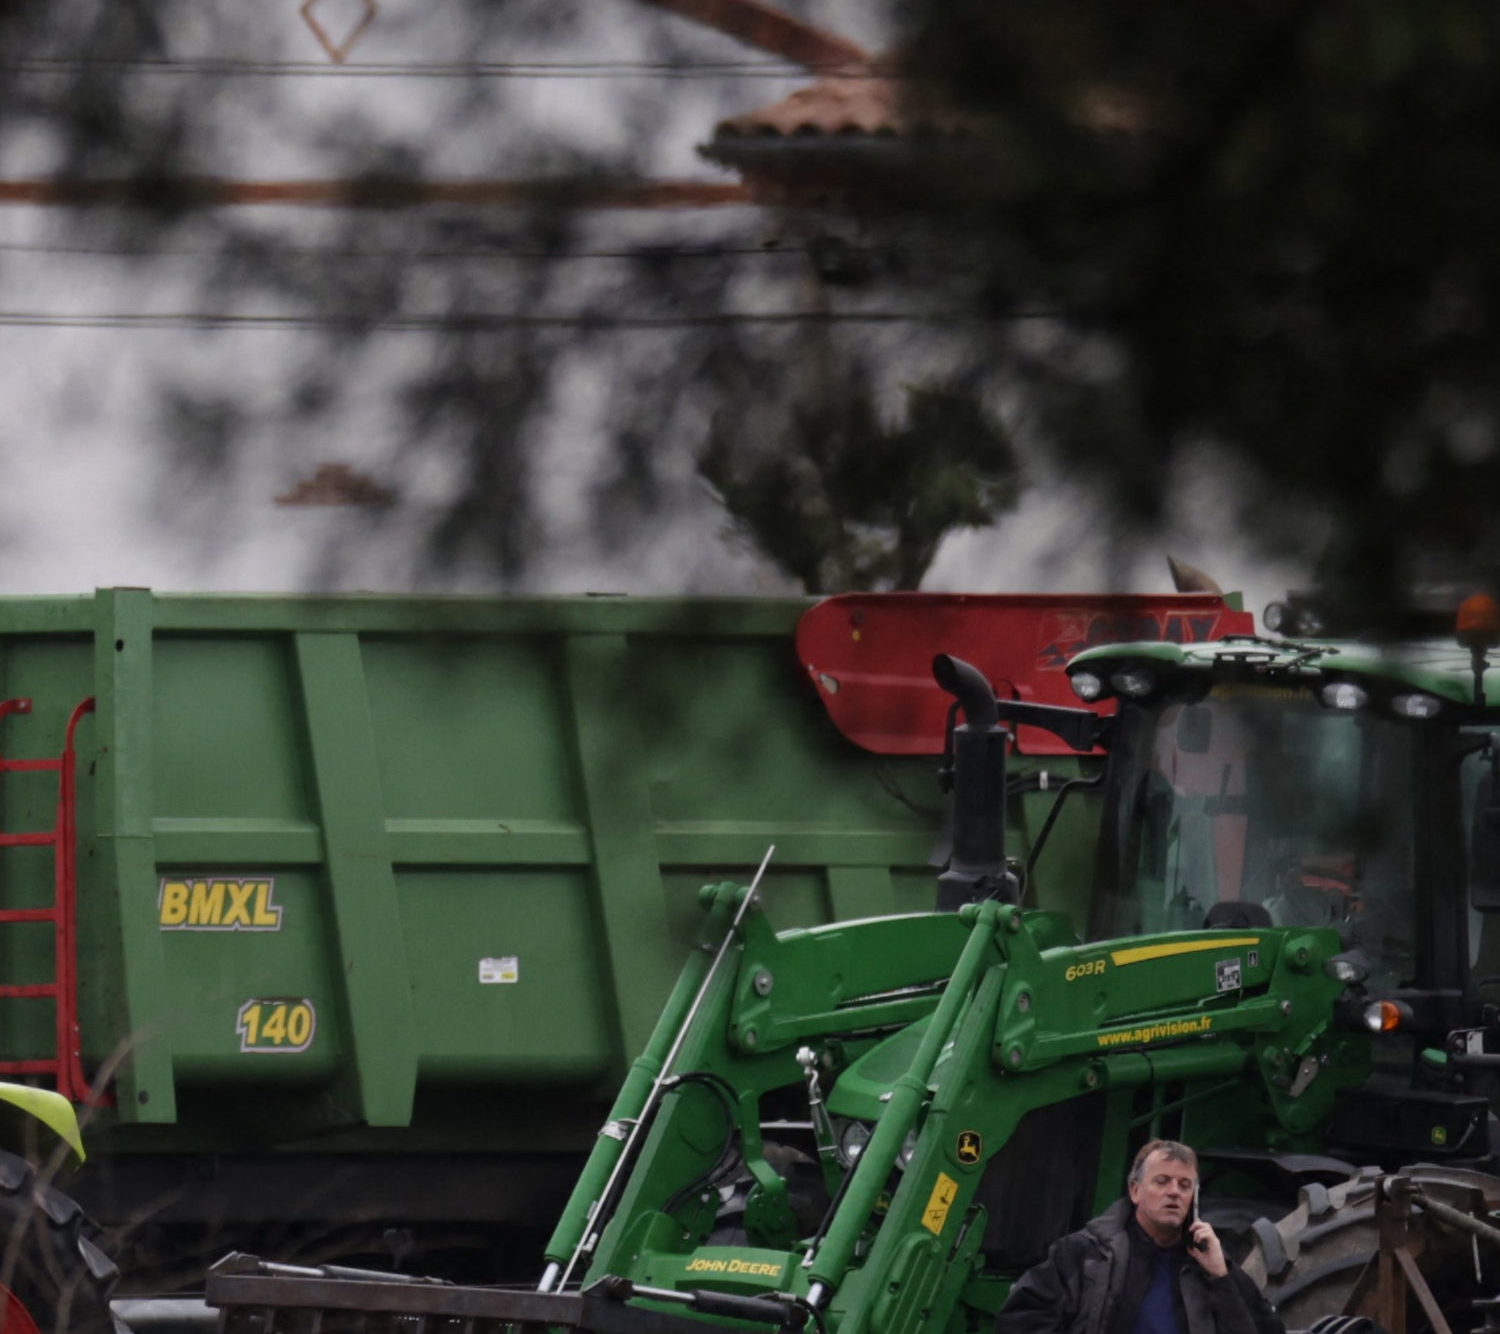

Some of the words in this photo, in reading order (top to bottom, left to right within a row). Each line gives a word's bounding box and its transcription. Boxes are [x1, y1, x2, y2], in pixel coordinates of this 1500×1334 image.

[159, 880, 278, 927] BMXL
[1065, 960, 1106, 982] 603R
[241, 1003, 313, 1046] 140
[1097, 1015, 1212, 1046] www.agrivision.fr
[685, 1257, 728, 1272] JOHN
[727, 1258, 781, 1277] DEERE
